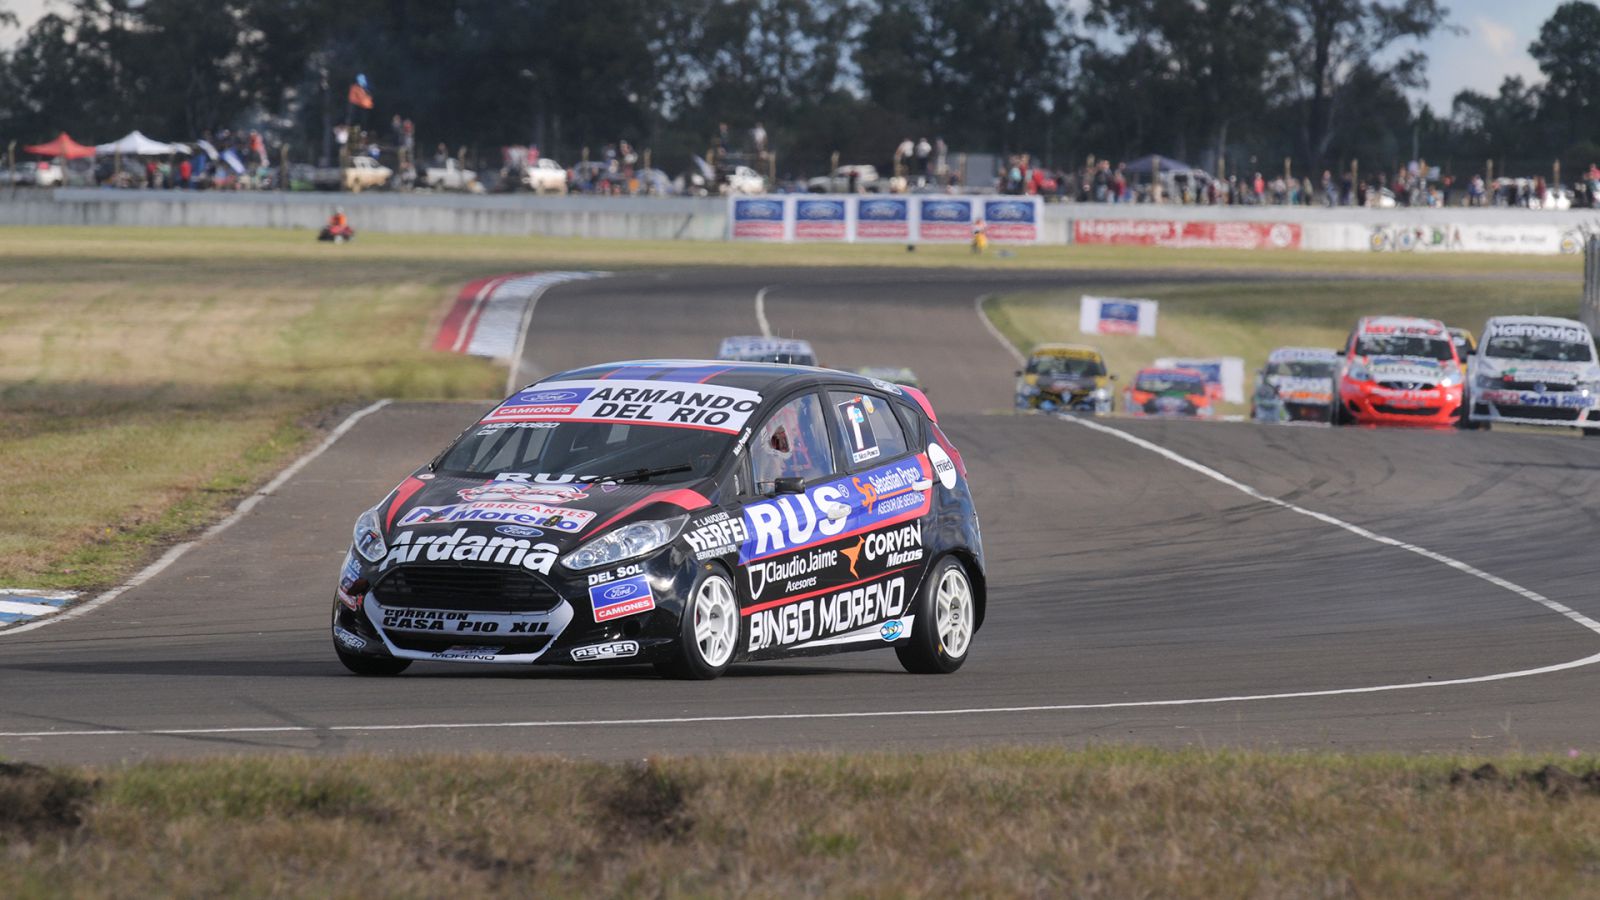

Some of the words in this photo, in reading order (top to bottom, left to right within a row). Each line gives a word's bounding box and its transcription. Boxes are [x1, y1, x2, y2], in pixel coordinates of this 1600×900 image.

[1491, 323, 1589, 343] Haimovich
[588, 387, 759, 413] ARMANDO
[498, 406, 571, 415] CAMIONES
[592, 403, 653, 420] DEL
[668, 407, 731, 426] RIO
[465, 501, 590, 519] LUBRICANTES
[702, 511, 730, 526] LAUQUEN
[745, 485, 848, 555] RUS
[864, 519, 923, 561] CORVEN
[379, 527, 561, 576] Ardama
[886, 548, 923, 568] Motos
[587, 572, 615, 586] DEL
[616, 564, 643, 578] SOL
[765, 555, 806, 583] Claudio
[807, 548, 838, 573] Jaime
[784, 575, 817, 593] Asesores
[383, 609, 469, 620] CORRALON
[598, 600, 650, 618] CAMIONES
[747, 599, 815, 652] BINGO
[818, 576, 906, 636] MORENO
[382, 616, 445, 631] CASA
[456, 621, 499, 633] PIO
[508, 621, 549, 633] XII
